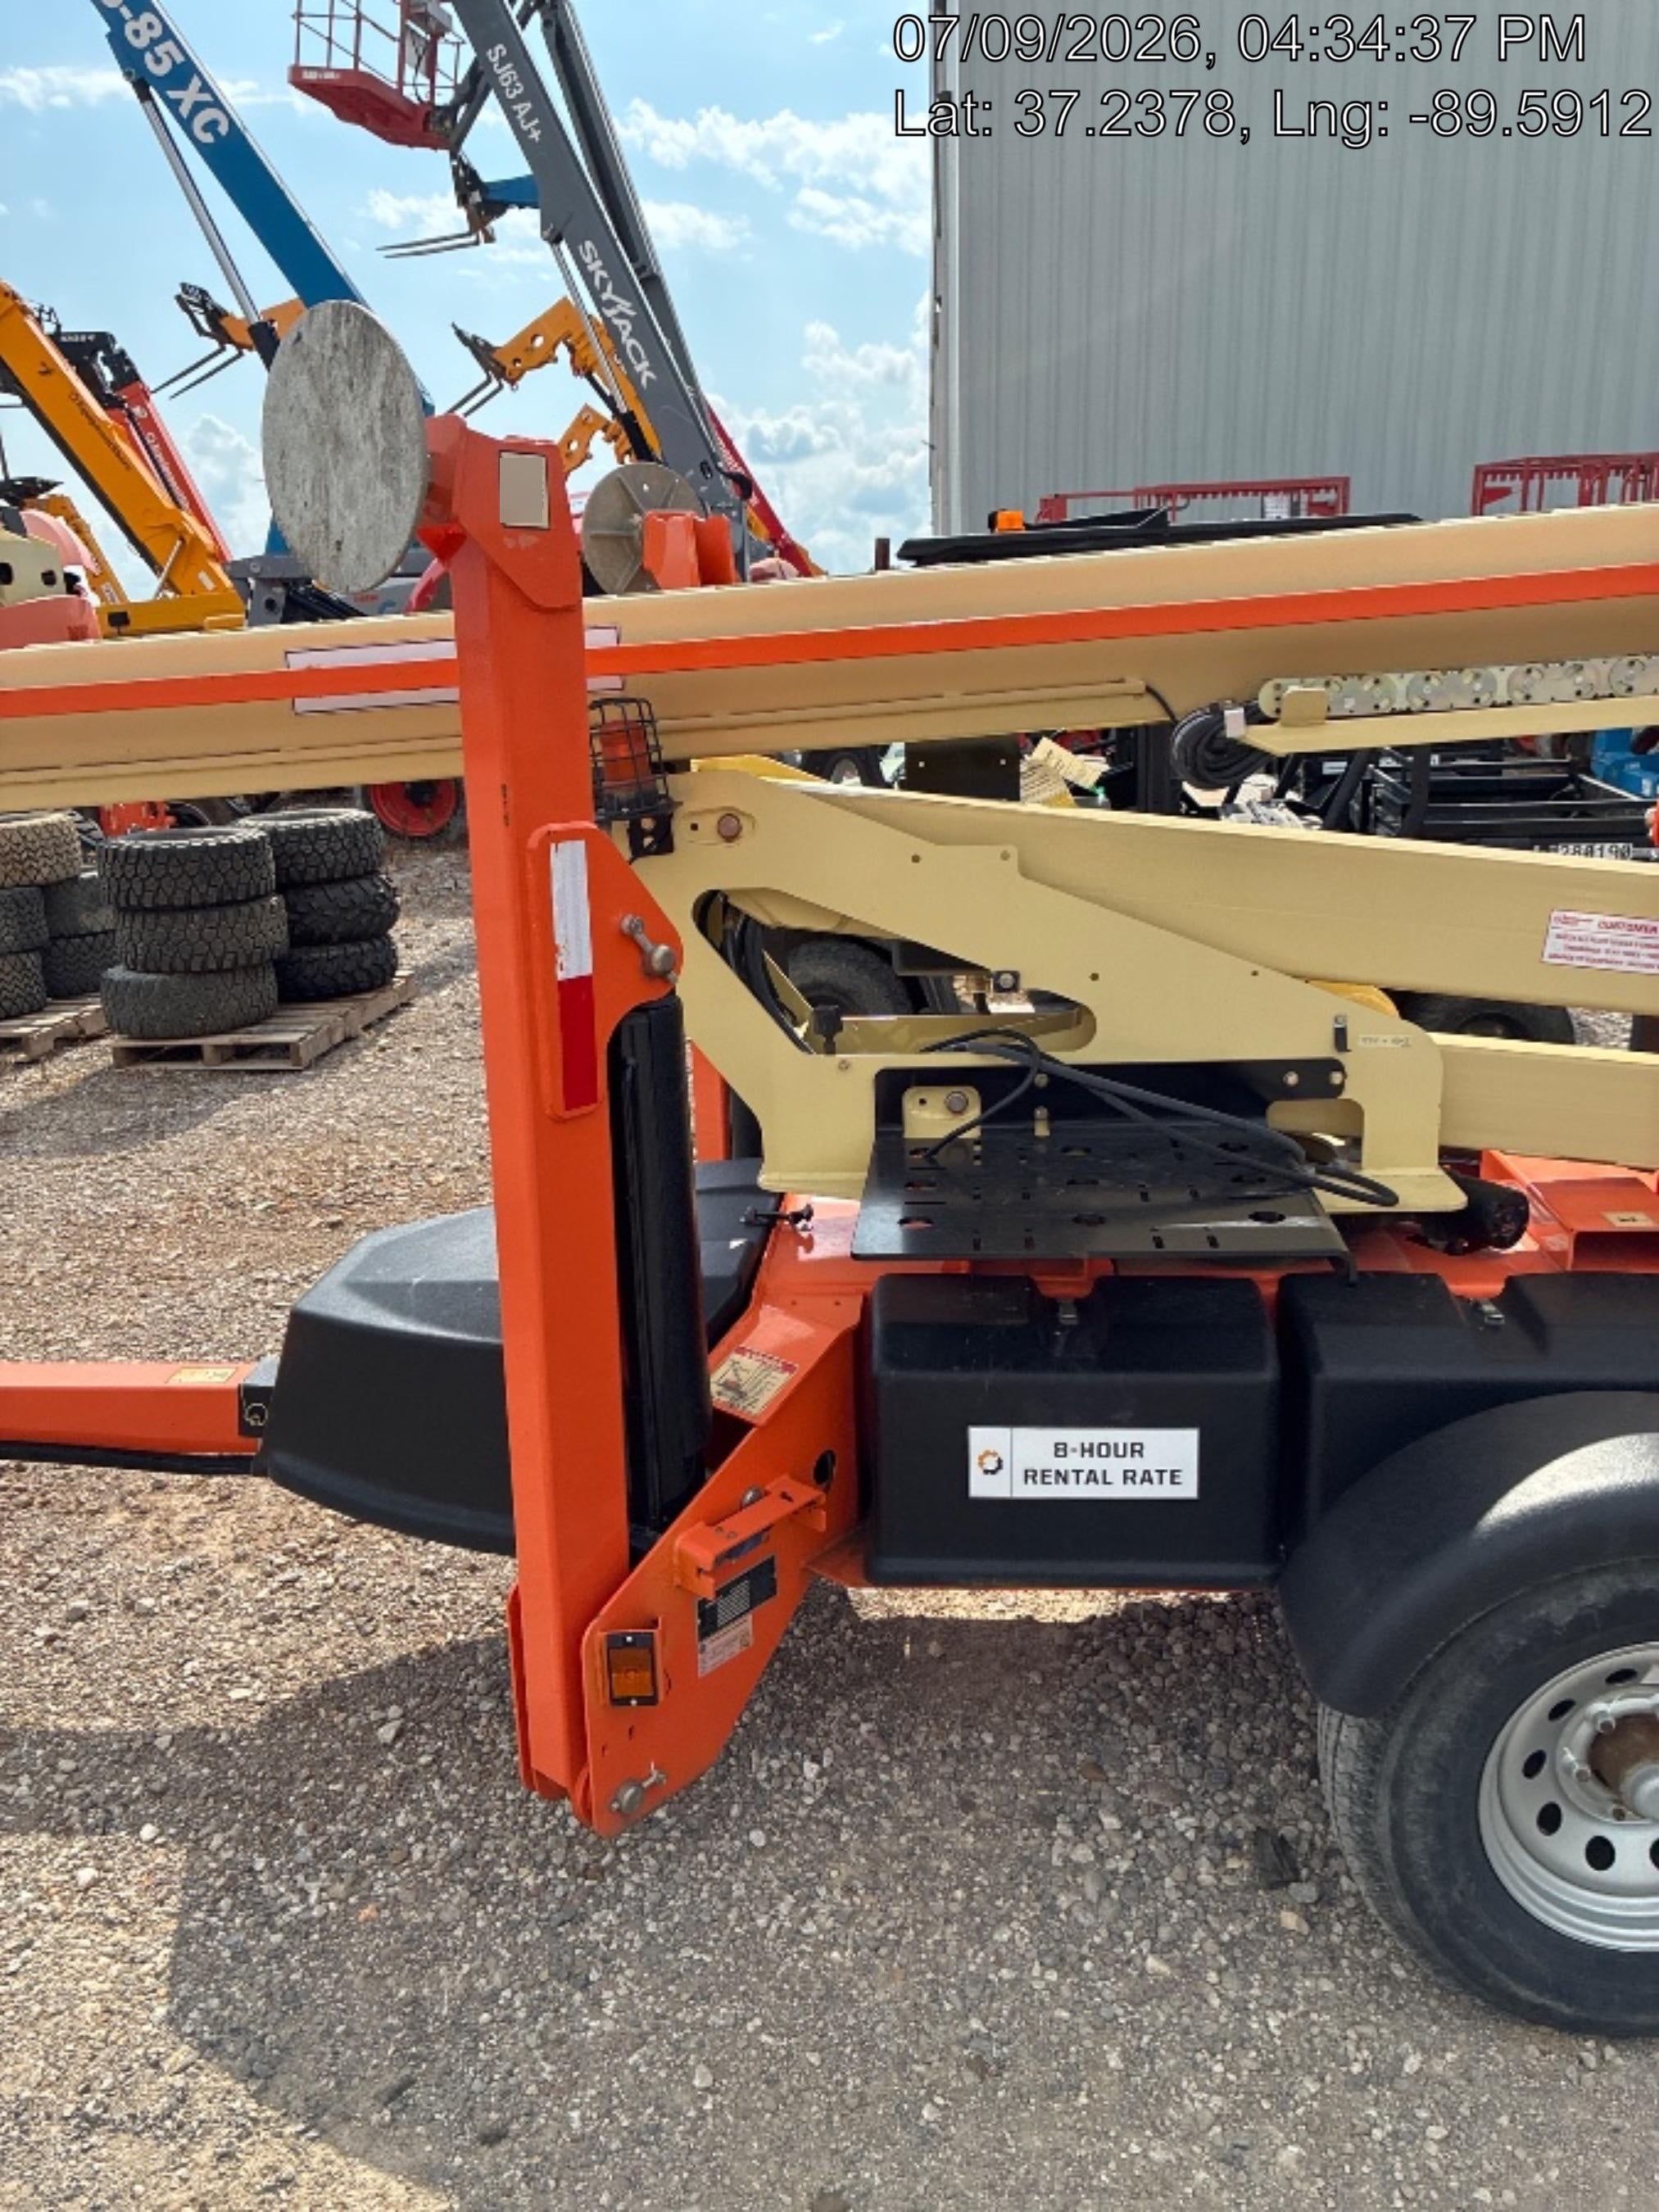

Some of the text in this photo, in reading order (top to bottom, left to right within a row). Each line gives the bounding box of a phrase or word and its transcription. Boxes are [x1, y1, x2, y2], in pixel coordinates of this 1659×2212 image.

[100, 0, 229, 143] -85 XC
[486, 43, 542, 143] SJ63 AJ+
[579, 239, 657, 390] SKYJACK
[1024, 1469, 1183, 1485] RENTAL RATE
[1054, 1442, 1145, 1458] 8-HOUR
